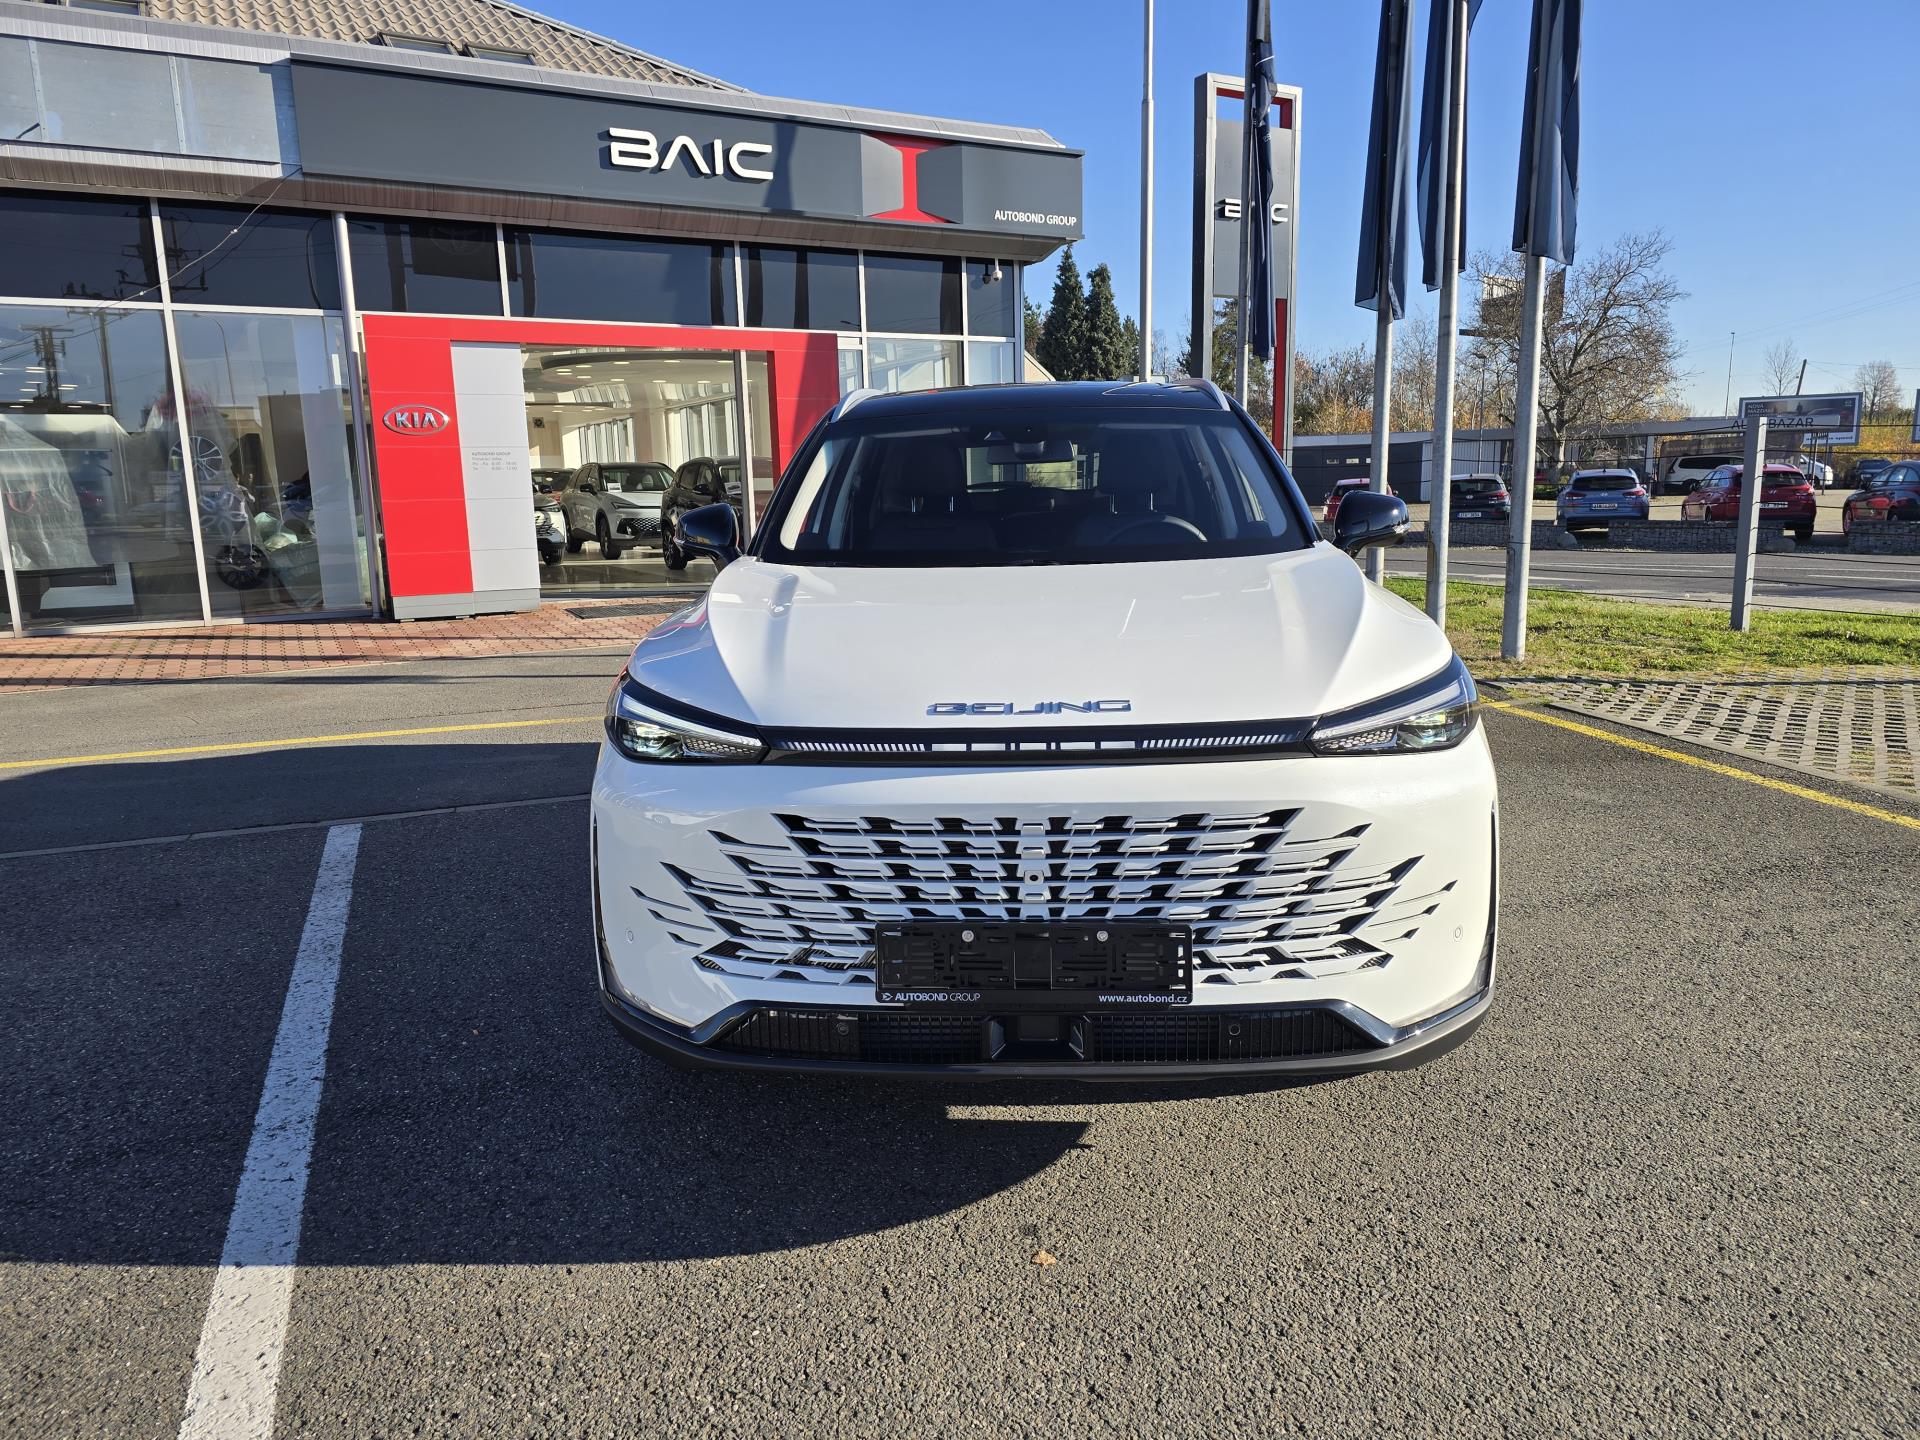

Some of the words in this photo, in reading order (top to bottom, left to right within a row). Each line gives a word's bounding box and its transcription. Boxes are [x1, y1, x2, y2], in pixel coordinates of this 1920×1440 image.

[609, 127, 774, 180] BAIC
[994, 210, 1045, 224] AUTOBOND
[1046, 214, 1077, 226] GROUP
[1224, 198, 1288, 222] BC
[394, 411, 438, 428] KIA
[926, 700, 1132, 716] BEIJING
[895, 992, 948, 1001] AUTOBOND
[949, 992, 981, 1002] GROUP
[1098, 993, 1188, 1003] www.autobond.cz
